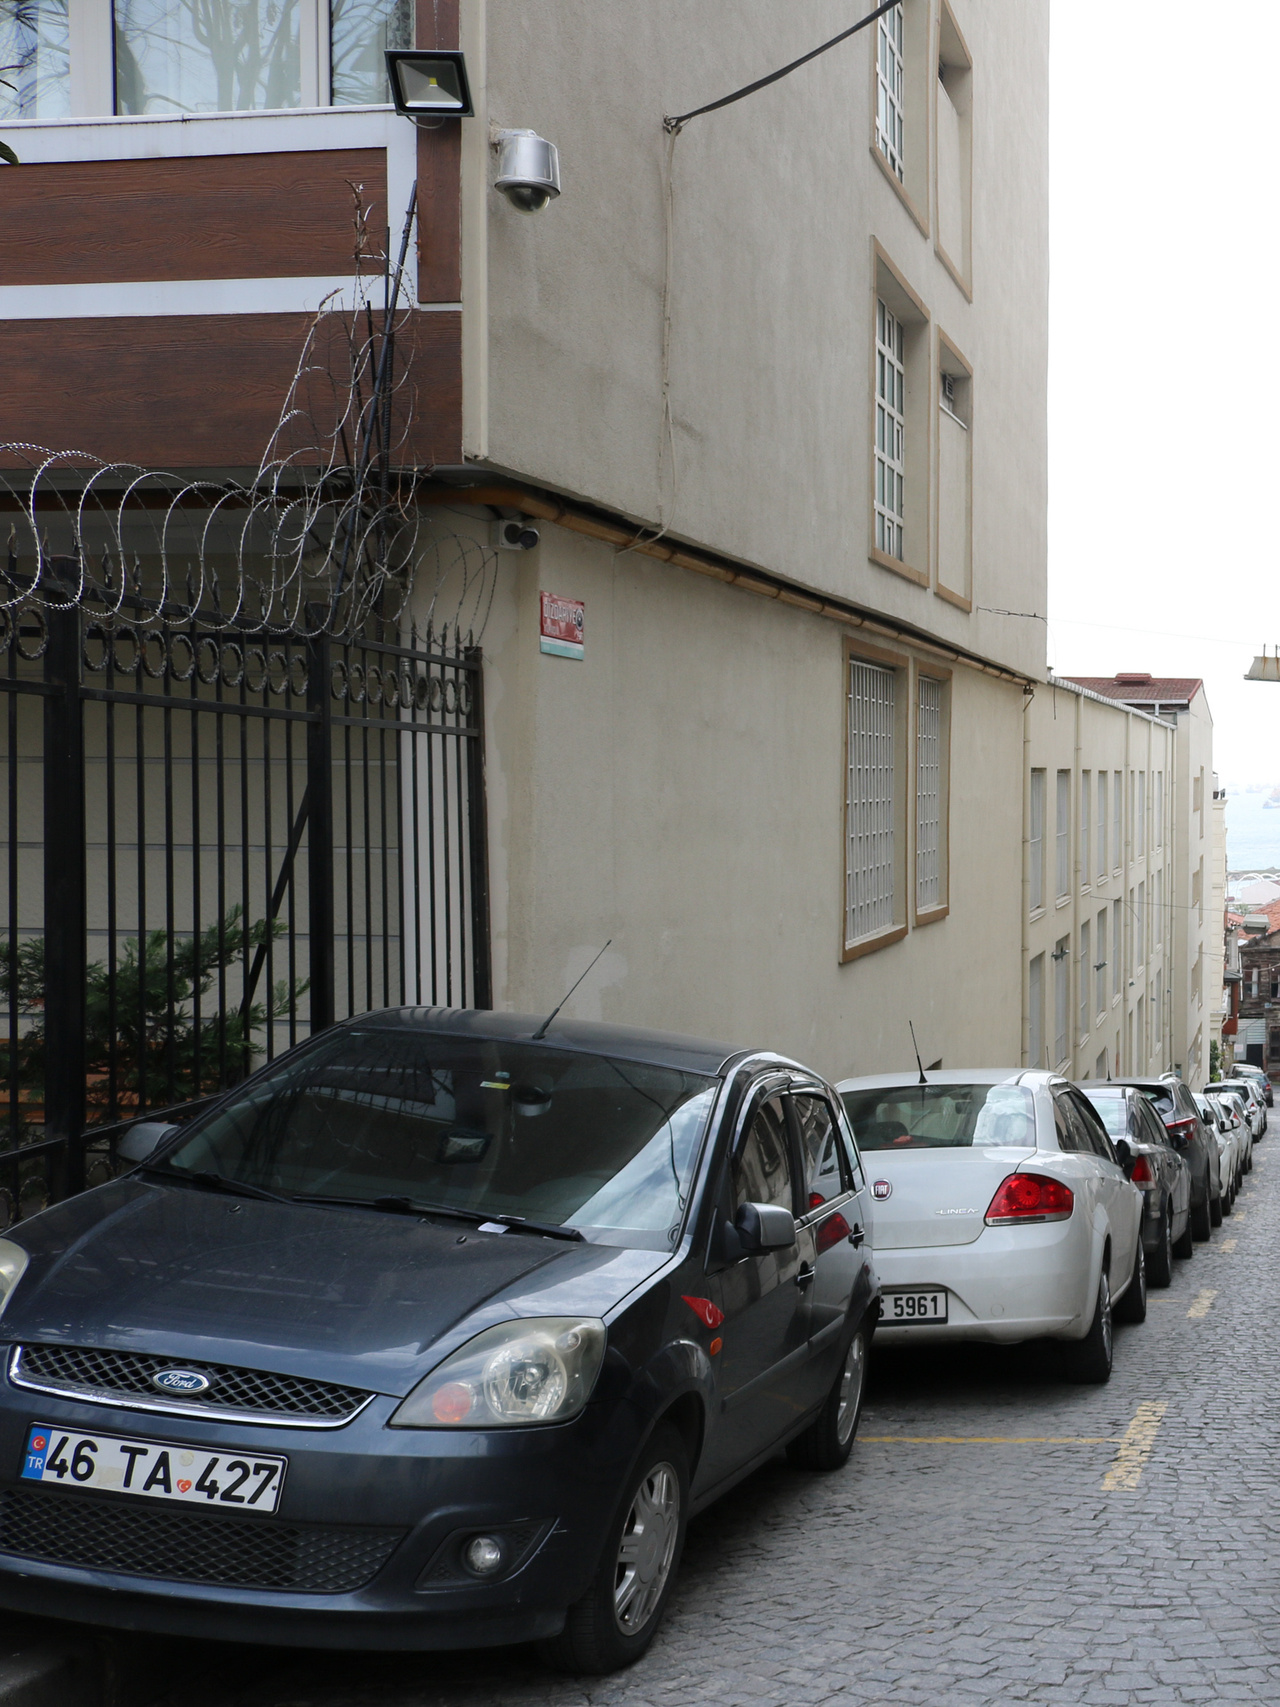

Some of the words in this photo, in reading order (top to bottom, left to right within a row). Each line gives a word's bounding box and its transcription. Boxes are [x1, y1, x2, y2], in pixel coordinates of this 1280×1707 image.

[875, 1185, 888, 1195] FIAT
[894, 1295, 938, 1317] 5961
[163, 1373, 197, 1389] Ford
[28, 1456, 43, 1470] TR
[46, 1436, 98, 1481] 46
[119, 1445, 172, 1494] TA
[195, 1457, 278, 1504] 427
